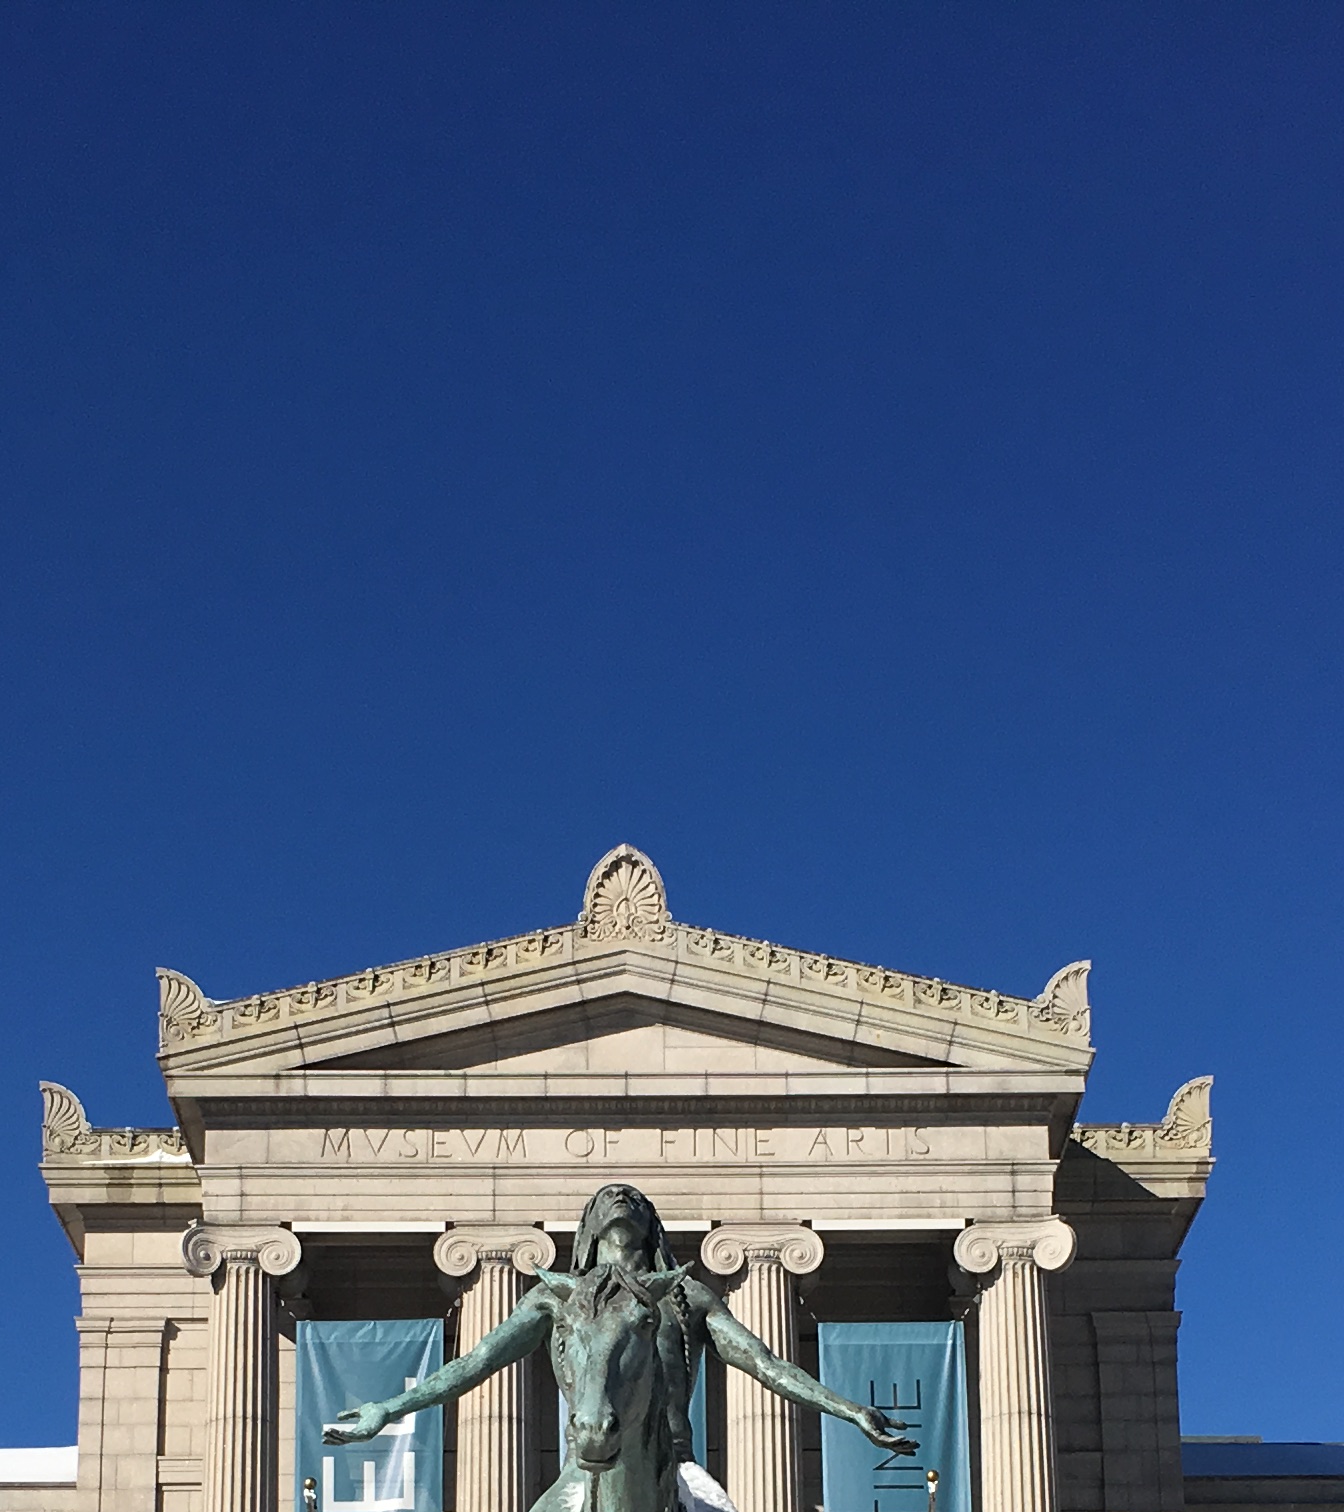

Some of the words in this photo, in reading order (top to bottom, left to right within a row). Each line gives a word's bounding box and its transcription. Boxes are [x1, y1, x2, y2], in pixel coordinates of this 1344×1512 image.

[321, 1127, 528, 1159] MVSEVM
[564, 1128, 624, 1158] OF
[659, 1128, 776, 1158] FINE
[807, 1126, 932, 1157] ARTS
